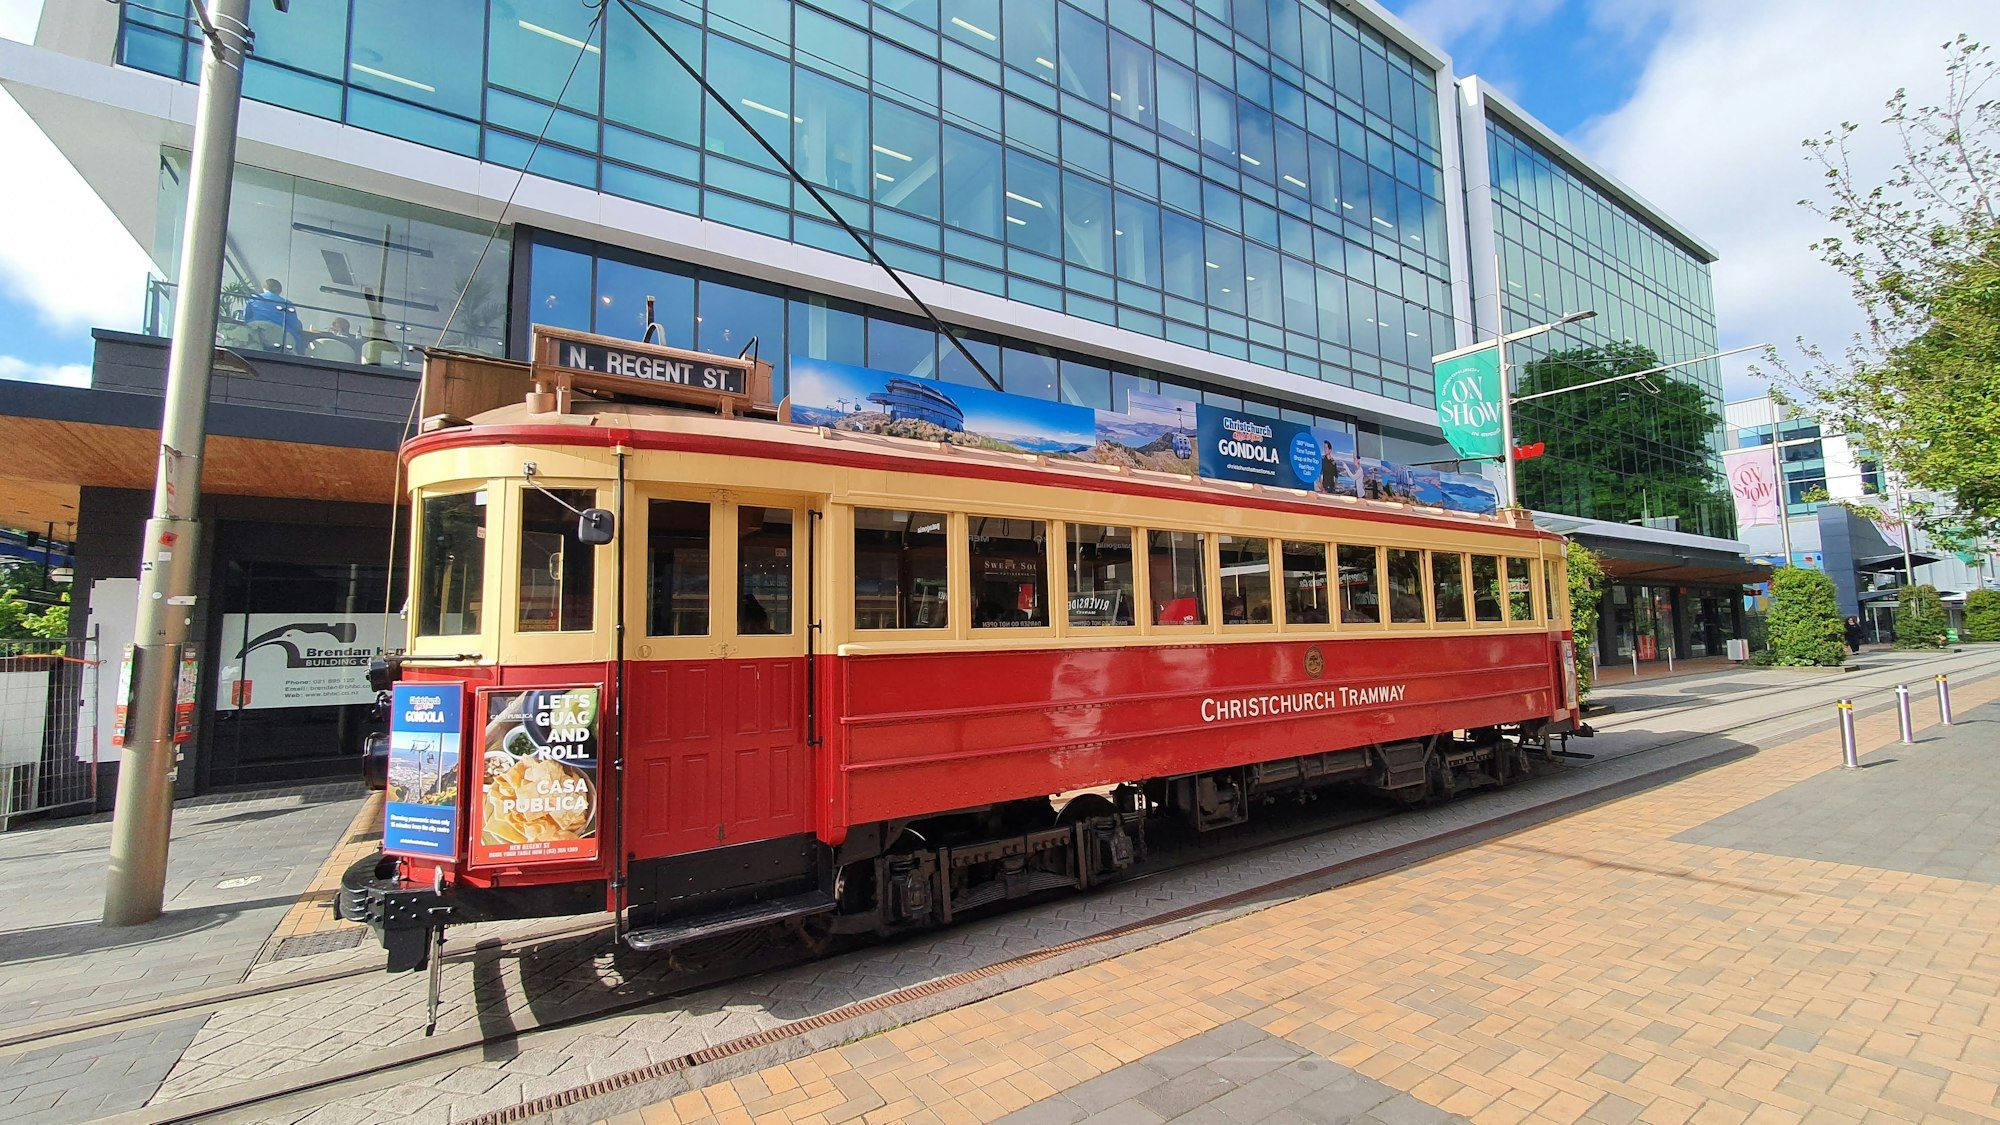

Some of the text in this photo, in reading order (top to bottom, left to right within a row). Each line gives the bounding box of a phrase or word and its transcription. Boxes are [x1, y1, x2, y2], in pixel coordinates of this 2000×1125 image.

[569, 345, 734, 392] N. REGENT ST.
[1452, 376, 1482, 403] ON
[1440, 400, 1501, 428] SHOW
[1223, 418, 1272, 437] Christchurch
[1218, 440, 1280, 464] GONDOLA
[1741, 467, 1760, 486] ON
[1733, 483, 1772, 502] SHOW
[306, 648, 371, 656] Brendan
[306, 658, 356, 667] BUILDING
[538, 694, 590, 710] LET'S
[1200, 684, 1406, 722] CHRISTCHURCH TRAMWAY
[406, 711, 444, 722] GONDOLA
[536, 712, 590, 727] GUAC
[546, 728, 590, 743] AND
[538, 744, 590, 760] ROLL
[536, 778, 588, 795] CASA
[503, 796, 589, 814] PUBLICA
